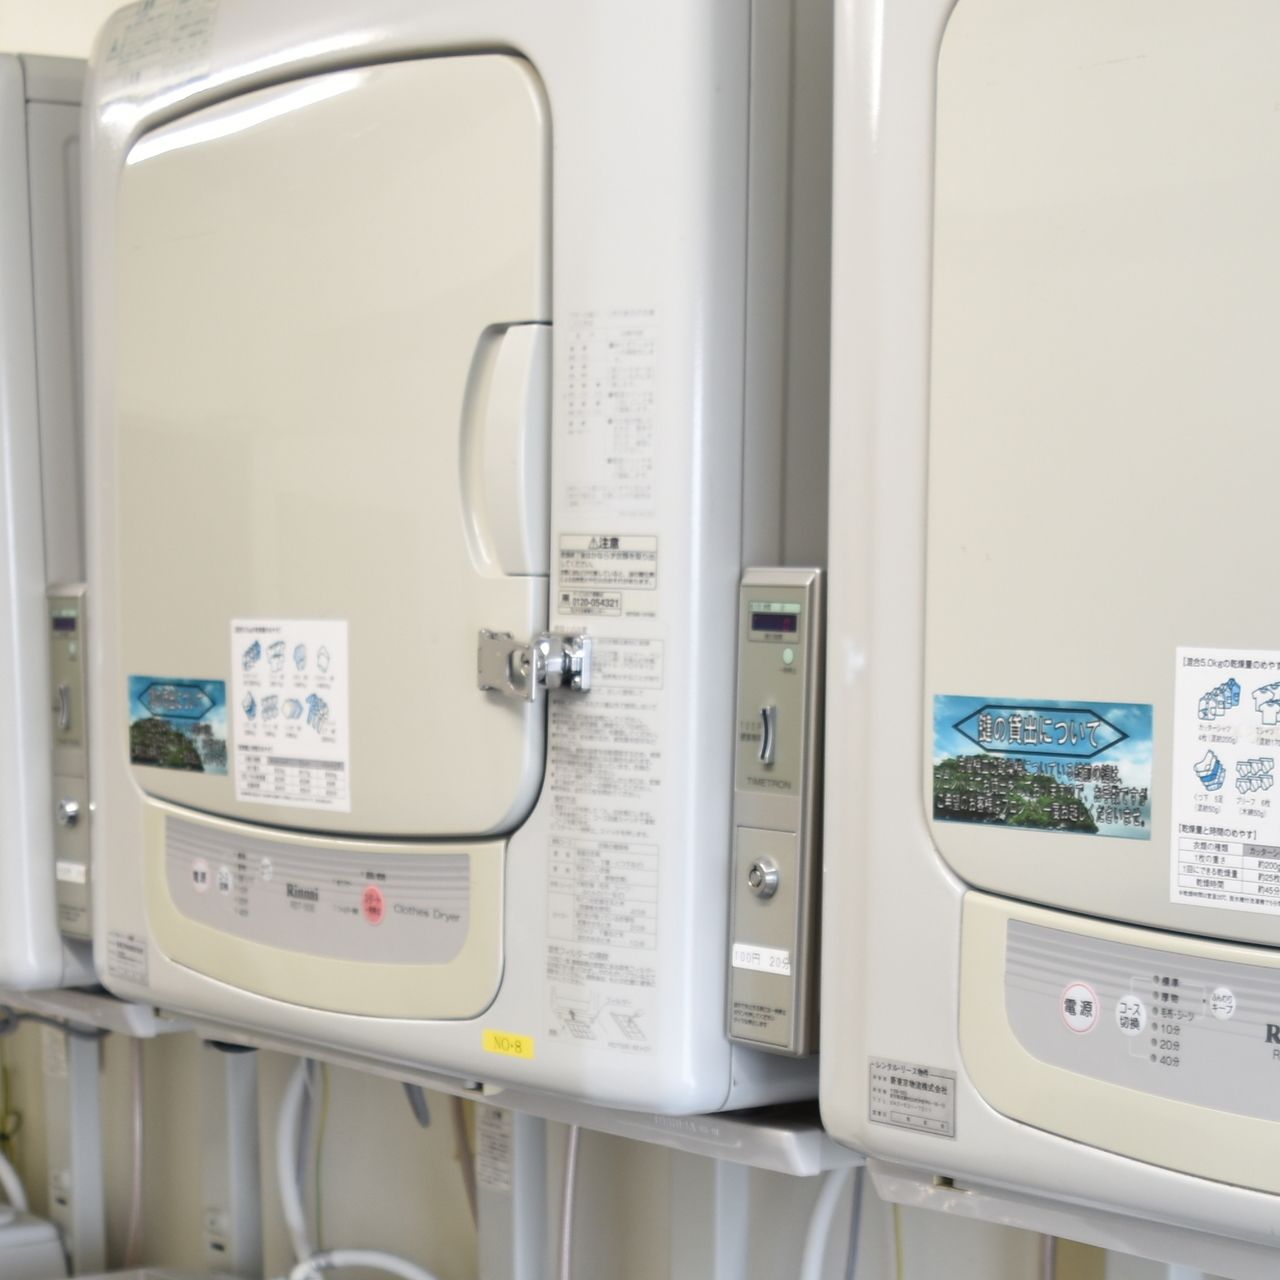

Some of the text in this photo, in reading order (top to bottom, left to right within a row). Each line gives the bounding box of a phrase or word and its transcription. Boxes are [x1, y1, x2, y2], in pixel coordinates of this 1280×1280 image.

[978, 713, 1101, 748] 鍵の貸出について
[1258, 872, 1280, 884] 約25枚
[286, 883, 319, 901] Rinnai
[1196, 878, 1224, 890] 乾燥時間
[1258, 885, 1280, 896] 約45分
[393, 903, 460, 922] Clothes Dryer
[1064, 998, 1093, 1018] 電源
[1120, 1003, 1141, 1016] コース
[1212, 1004, 1233, 1015] キープ
[1119, 1016, 1141, 1031] 切換
[1160, 1024, 1180, 1035] 10分
[1160, 1040, 1180, 1051] 20分
[1159, 1055, 1180, 1067] 40分
